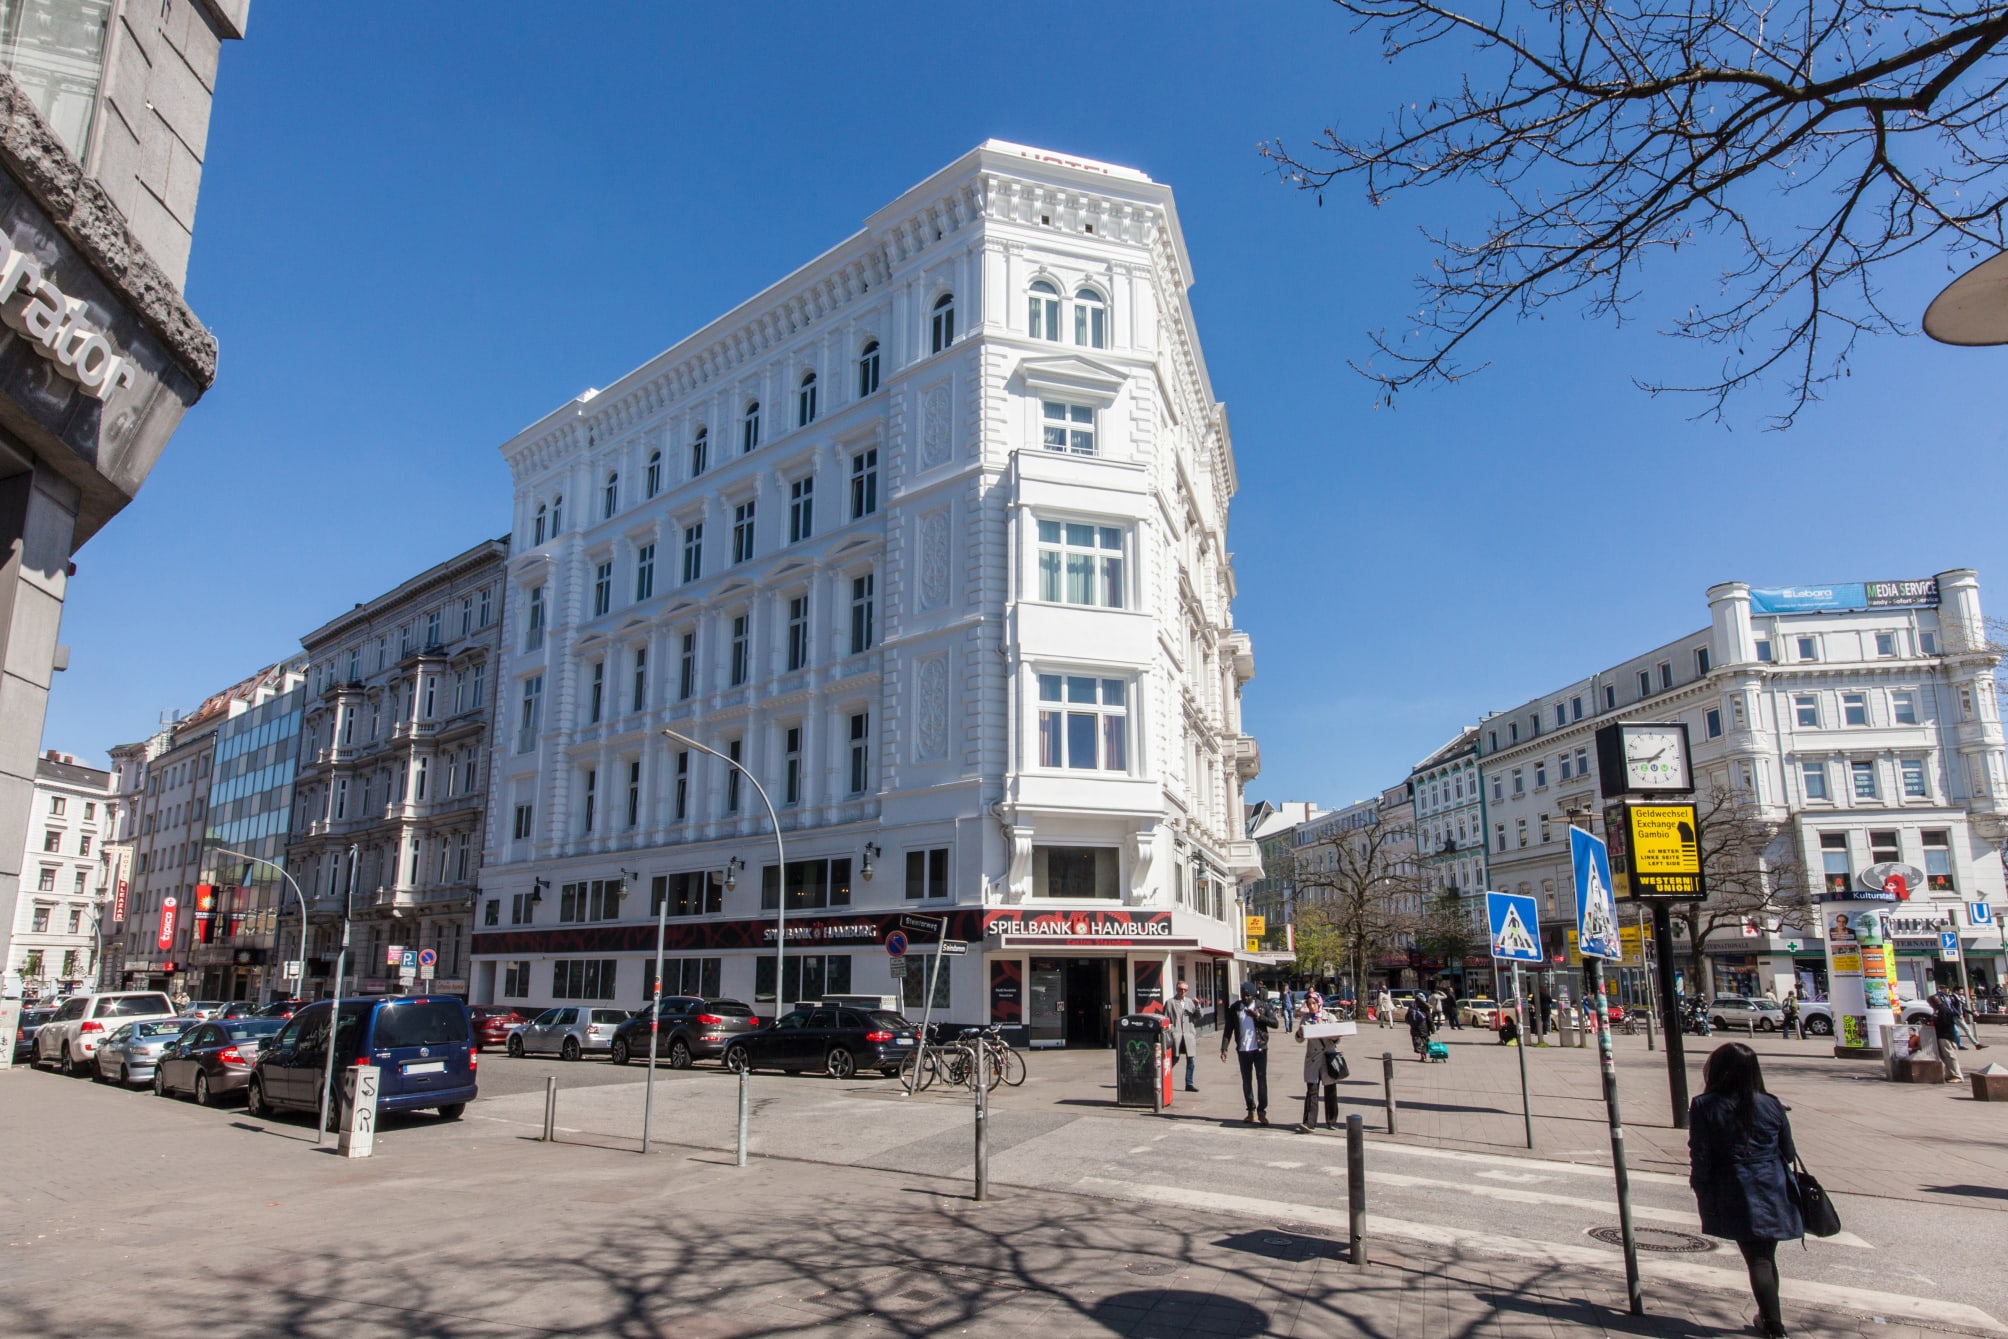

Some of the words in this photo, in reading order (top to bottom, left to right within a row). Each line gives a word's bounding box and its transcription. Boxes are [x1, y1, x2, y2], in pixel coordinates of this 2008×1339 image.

[1792, 589, 1833, 598] Lebara
[1636, 809, 1688, 818] Geldwechsel
[1637, 820, 1676, 831] Exchange
[1638, 830, 1670, 839] Gambio
[1640, 877, 1691, 885] WESTERN
[1656, 884, 1691, 892] UNION
[1972, 903, 1989, 923] U
[160, 911, 173, 942] tipico
[989, 921, 1072, 935] SPIELBANK
[1091, 922, 1168, 935] HAMBURG
[763, 928, 812, 941] SPILBANK
[823, 924, 878, 938] HAMBURG
[403, 952, 413, 965] P
